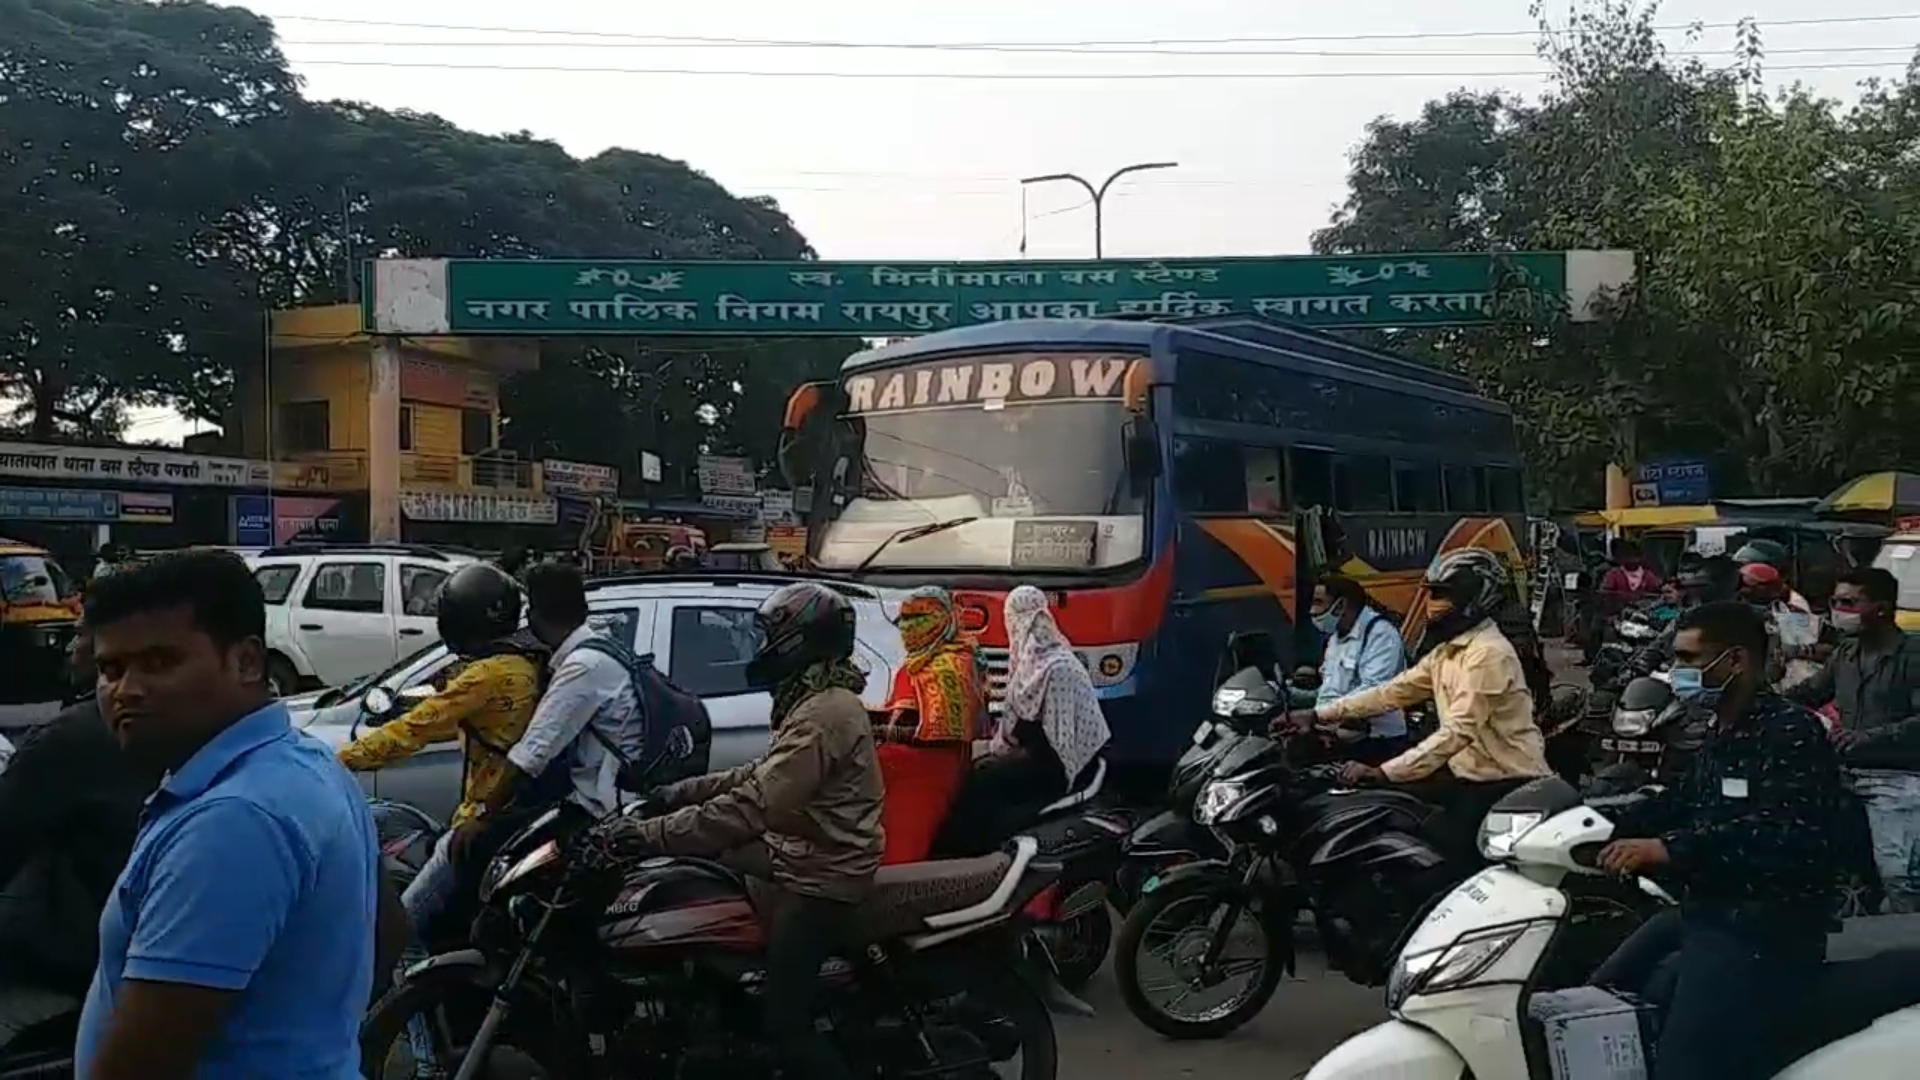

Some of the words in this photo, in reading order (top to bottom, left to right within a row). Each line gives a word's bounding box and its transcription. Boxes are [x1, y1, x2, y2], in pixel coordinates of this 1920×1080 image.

[869, 266, 1047, 287] मिनीमाता
[1060, 269, 1118, 285] बस
[466, 301, 551, 321] नगर
[568, 294, 697, 322] पालिक
[715, 294, 824, 322] निगम
[840, 302, 953, 330] रायपुर
[969, 301, 1100, 320] आपका
[1252, 295, 1372, 316] स्वागत
[845, 357, 1125, 412] RAINBOW
[63, 457, 95, 472] थाना
[100, 459, 122, 473] बस
[1367, 528, 1426, 558] RAINBOW
